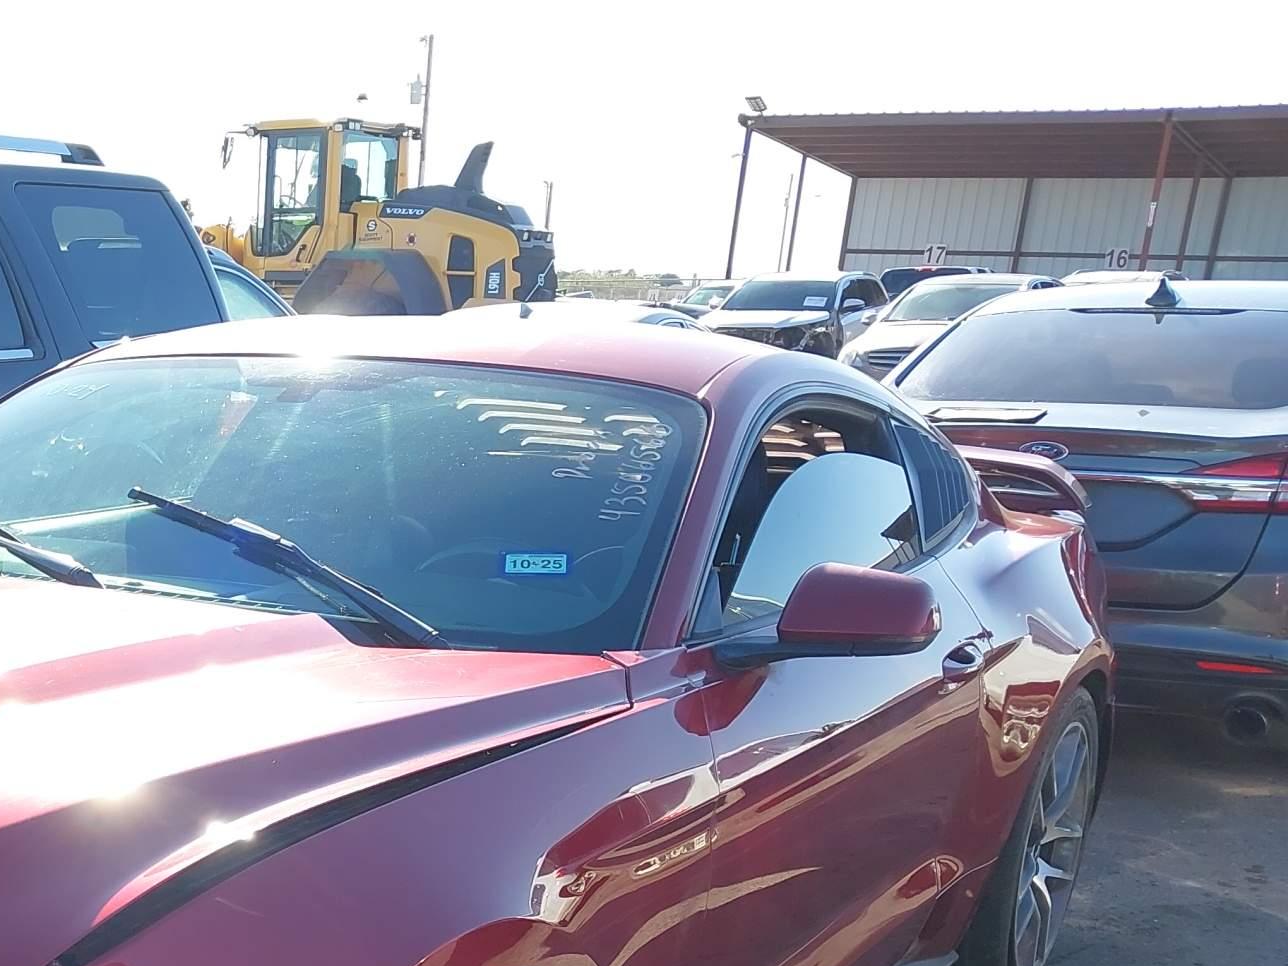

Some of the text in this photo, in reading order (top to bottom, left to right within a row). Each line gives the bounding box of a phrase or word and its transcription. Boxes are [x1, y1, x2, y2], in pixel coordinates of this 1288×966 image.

[386, 207, 424, 216] VOLVO
[925, 246, 947, 264] 17
[1106, 249, 1129, 268] 16
[488, 272, 500, 294] L90H
